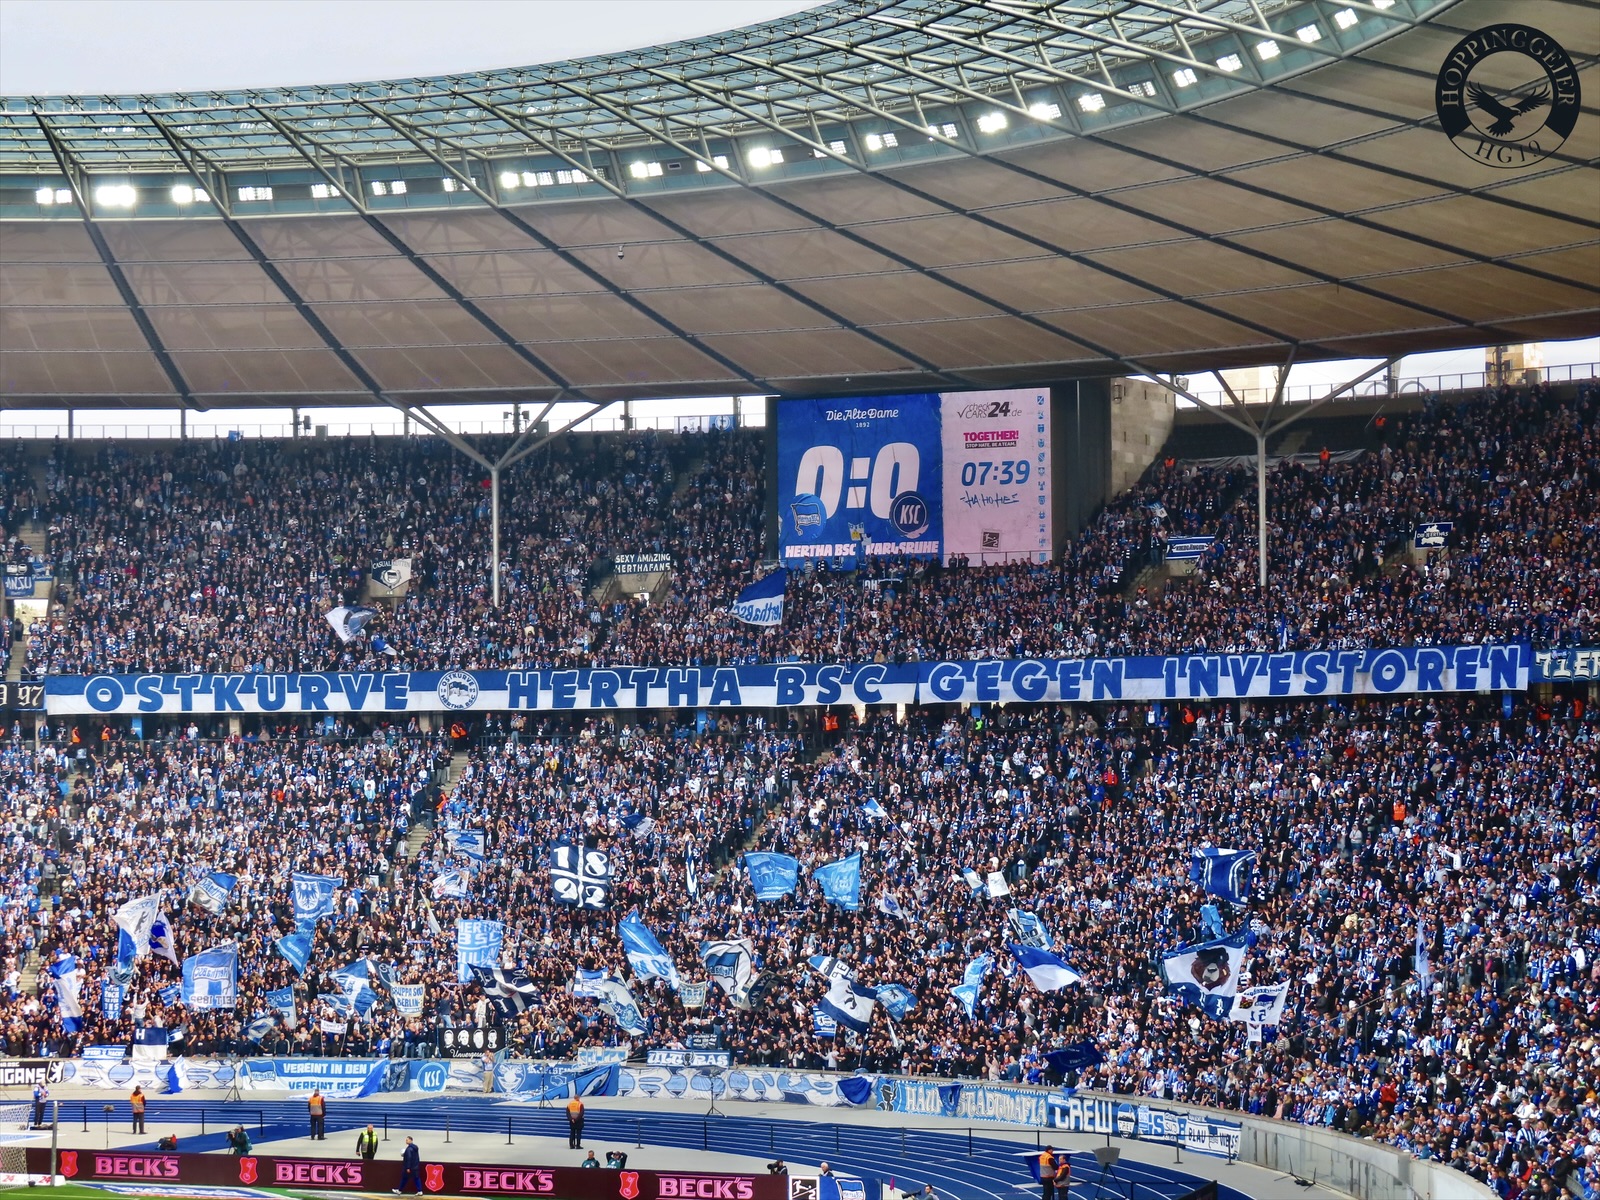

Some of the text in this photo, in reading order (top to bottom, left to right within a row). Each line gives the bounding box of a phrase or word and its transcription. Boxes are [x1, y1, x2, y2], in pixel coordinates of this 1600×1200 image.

[825, 408, 899, 421] Die Alte Dame
[963, 430, 1019, 441] TOGETHER!
[795, 442, 920, 520] 0:0
[961, 459, 1031, 487] 07:39
[899, 504, 921, 525] KSC
[785, 543, 857, 558] HERTHA BSC
[865, 541, 939, 556] KARLSRUHE
[615, 553, 671, 563] SEXY AMAZING
[615, 562, 671, 573] HERTHAFANS
[84, 645, 1520, 713] OSTKURVE HERTHA BSC GEGEN INVESTOREN
[441, 673, 475, 687] OSTKURVE
[441, 694, 465, 709] HERTHA
[283, 1062, 328, 1074] VEREINT
[330, 1063, 341, 1074] IN
[345, 1063, 368, 1074] DEN
[288, 1080, 334, 1090] VEREINT
[424, 1071, 441, 1088] KSC
[1189, 1127, 1206, 1144] BLAU
[95, 1155, 180, 1177] BECK'S
[275, 1161, 363, 1186] BECK'S
[463, 1168, 555, 1192] BECK'S
[658, 1176, 755, 1199] BECK'S
